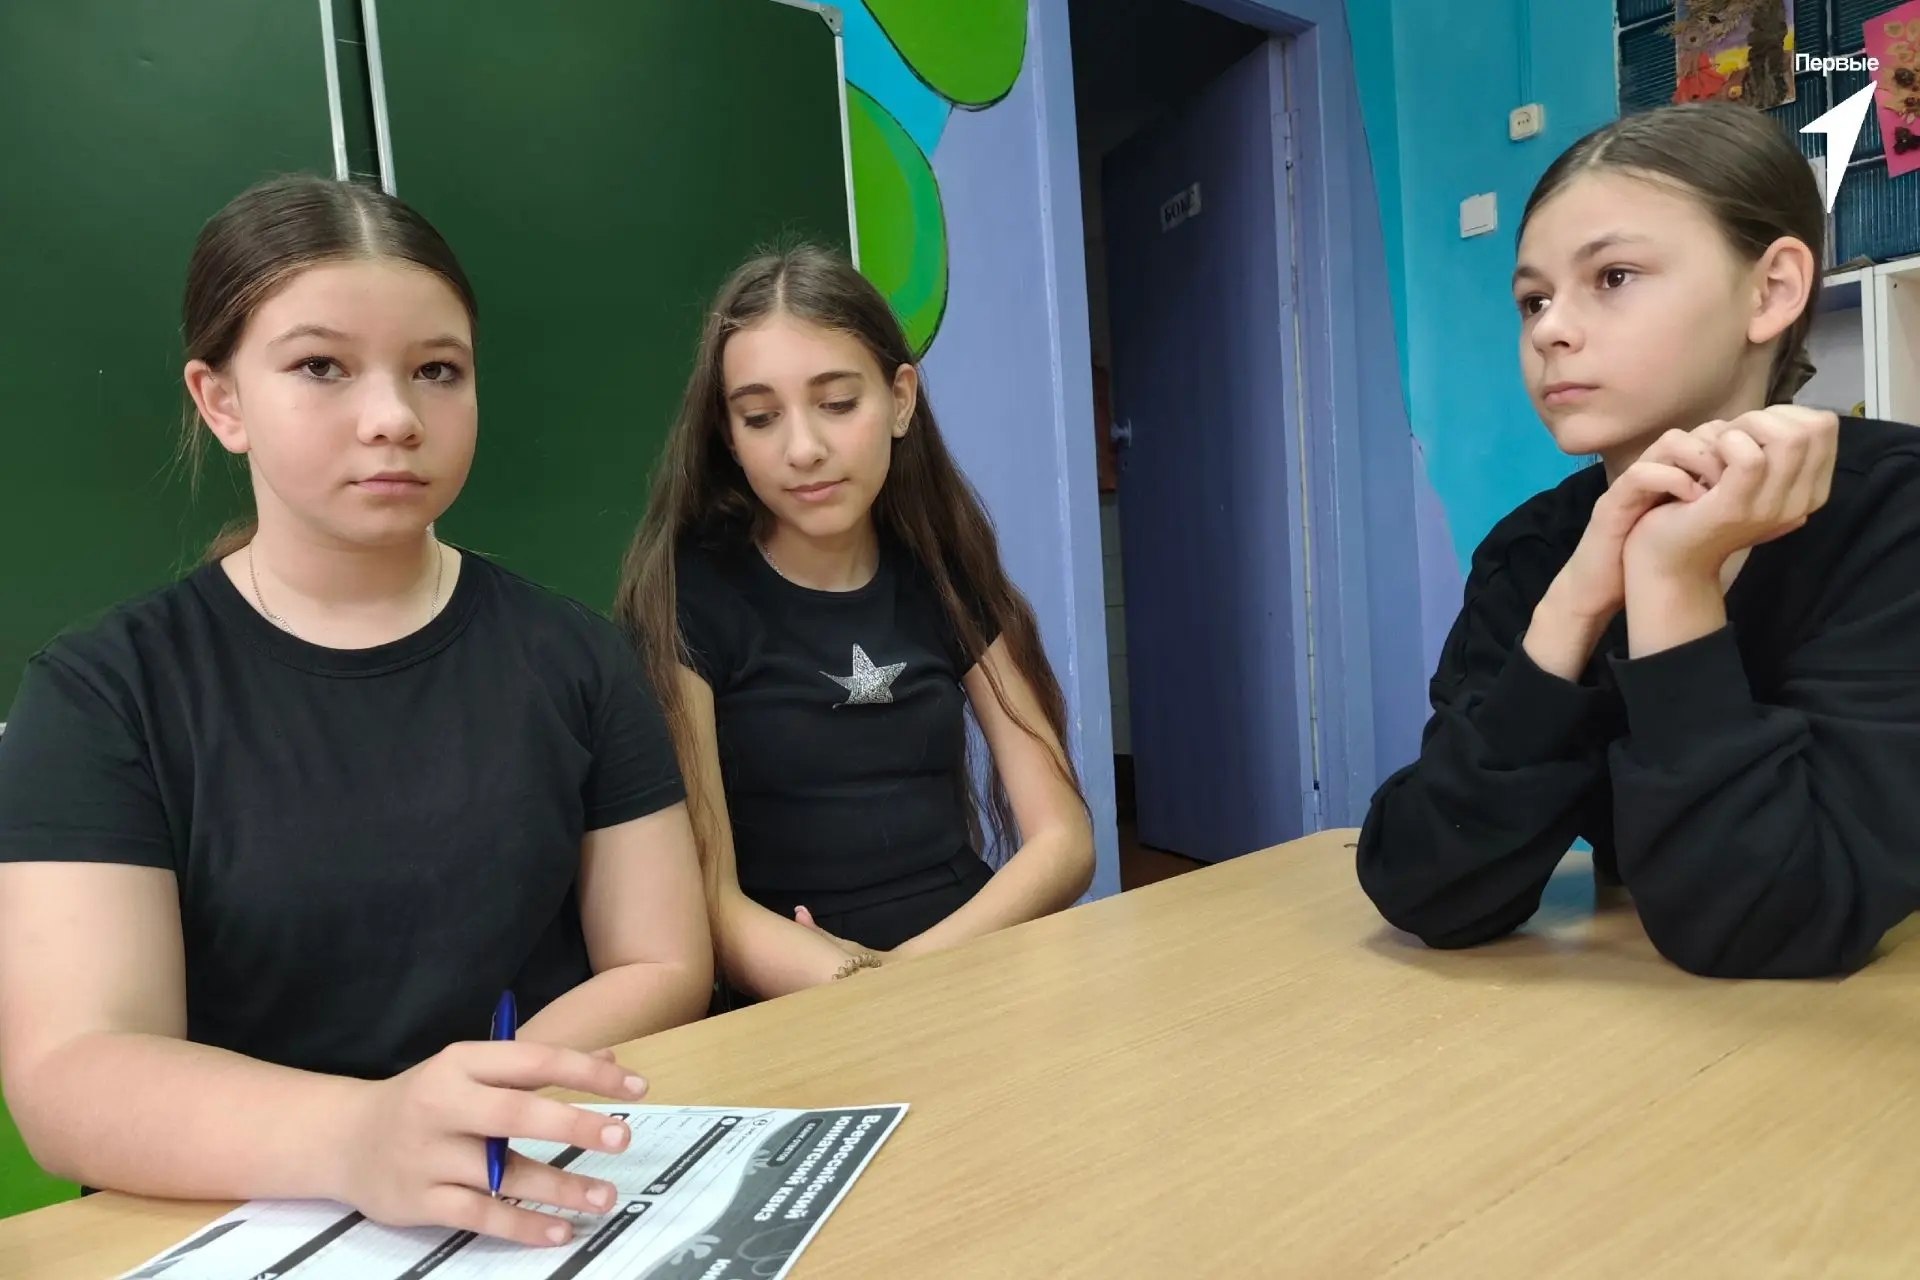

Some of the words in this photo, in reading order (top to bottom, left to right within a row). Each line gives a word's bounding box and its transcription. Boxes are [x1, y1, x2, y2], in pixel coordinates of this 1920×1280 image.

[784, 1115, 881, 1219] Всероссийский
[785, 1116, 852, 1185] юннатский
[754, 1187, 794, 1221] квиз
